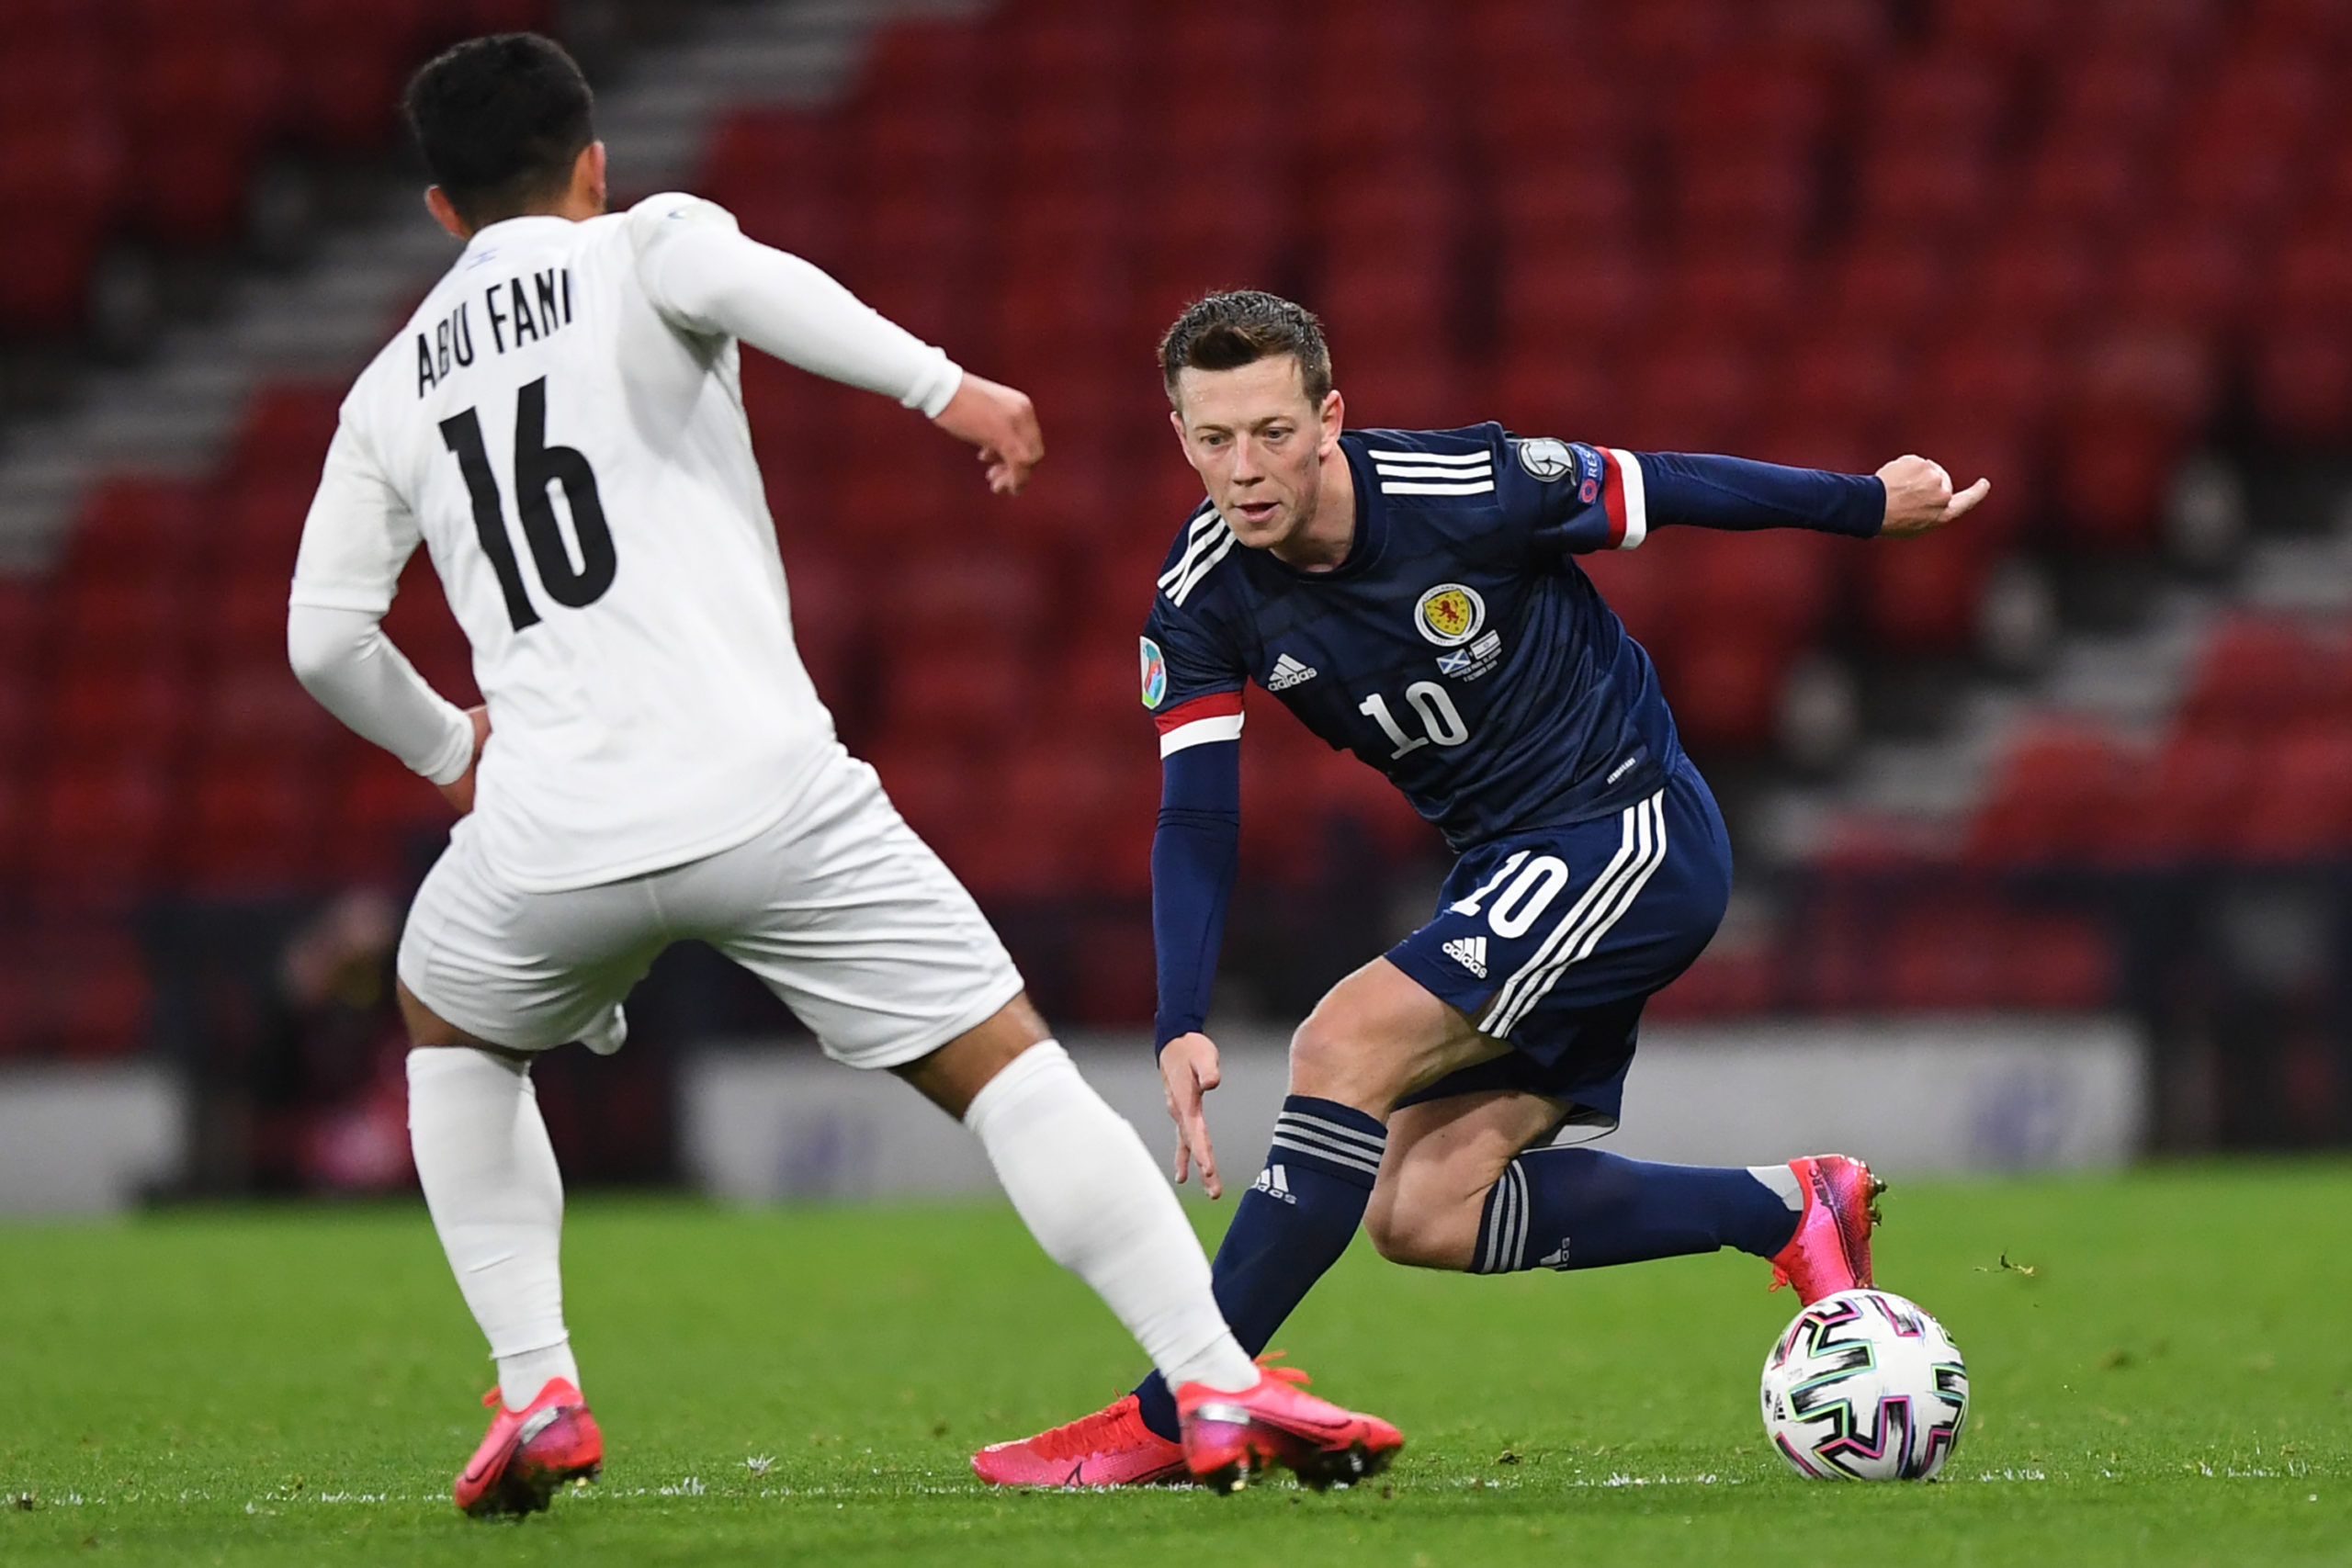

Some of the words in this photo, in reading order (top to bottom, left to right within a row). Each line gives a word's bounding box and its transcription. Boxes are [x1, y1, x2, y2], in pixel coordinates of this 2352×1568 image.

[417, 302, 474, 399] ABU
[486, 268, 572, 355] FANI
[438, 375, 617, 633] 16
[1268, 668, 1317, 691] adidas
[1359, 681, 1469, 761] 10
[1451, 850, 1569, 939] 10
[1442, 942, 1487, 978] adidas
